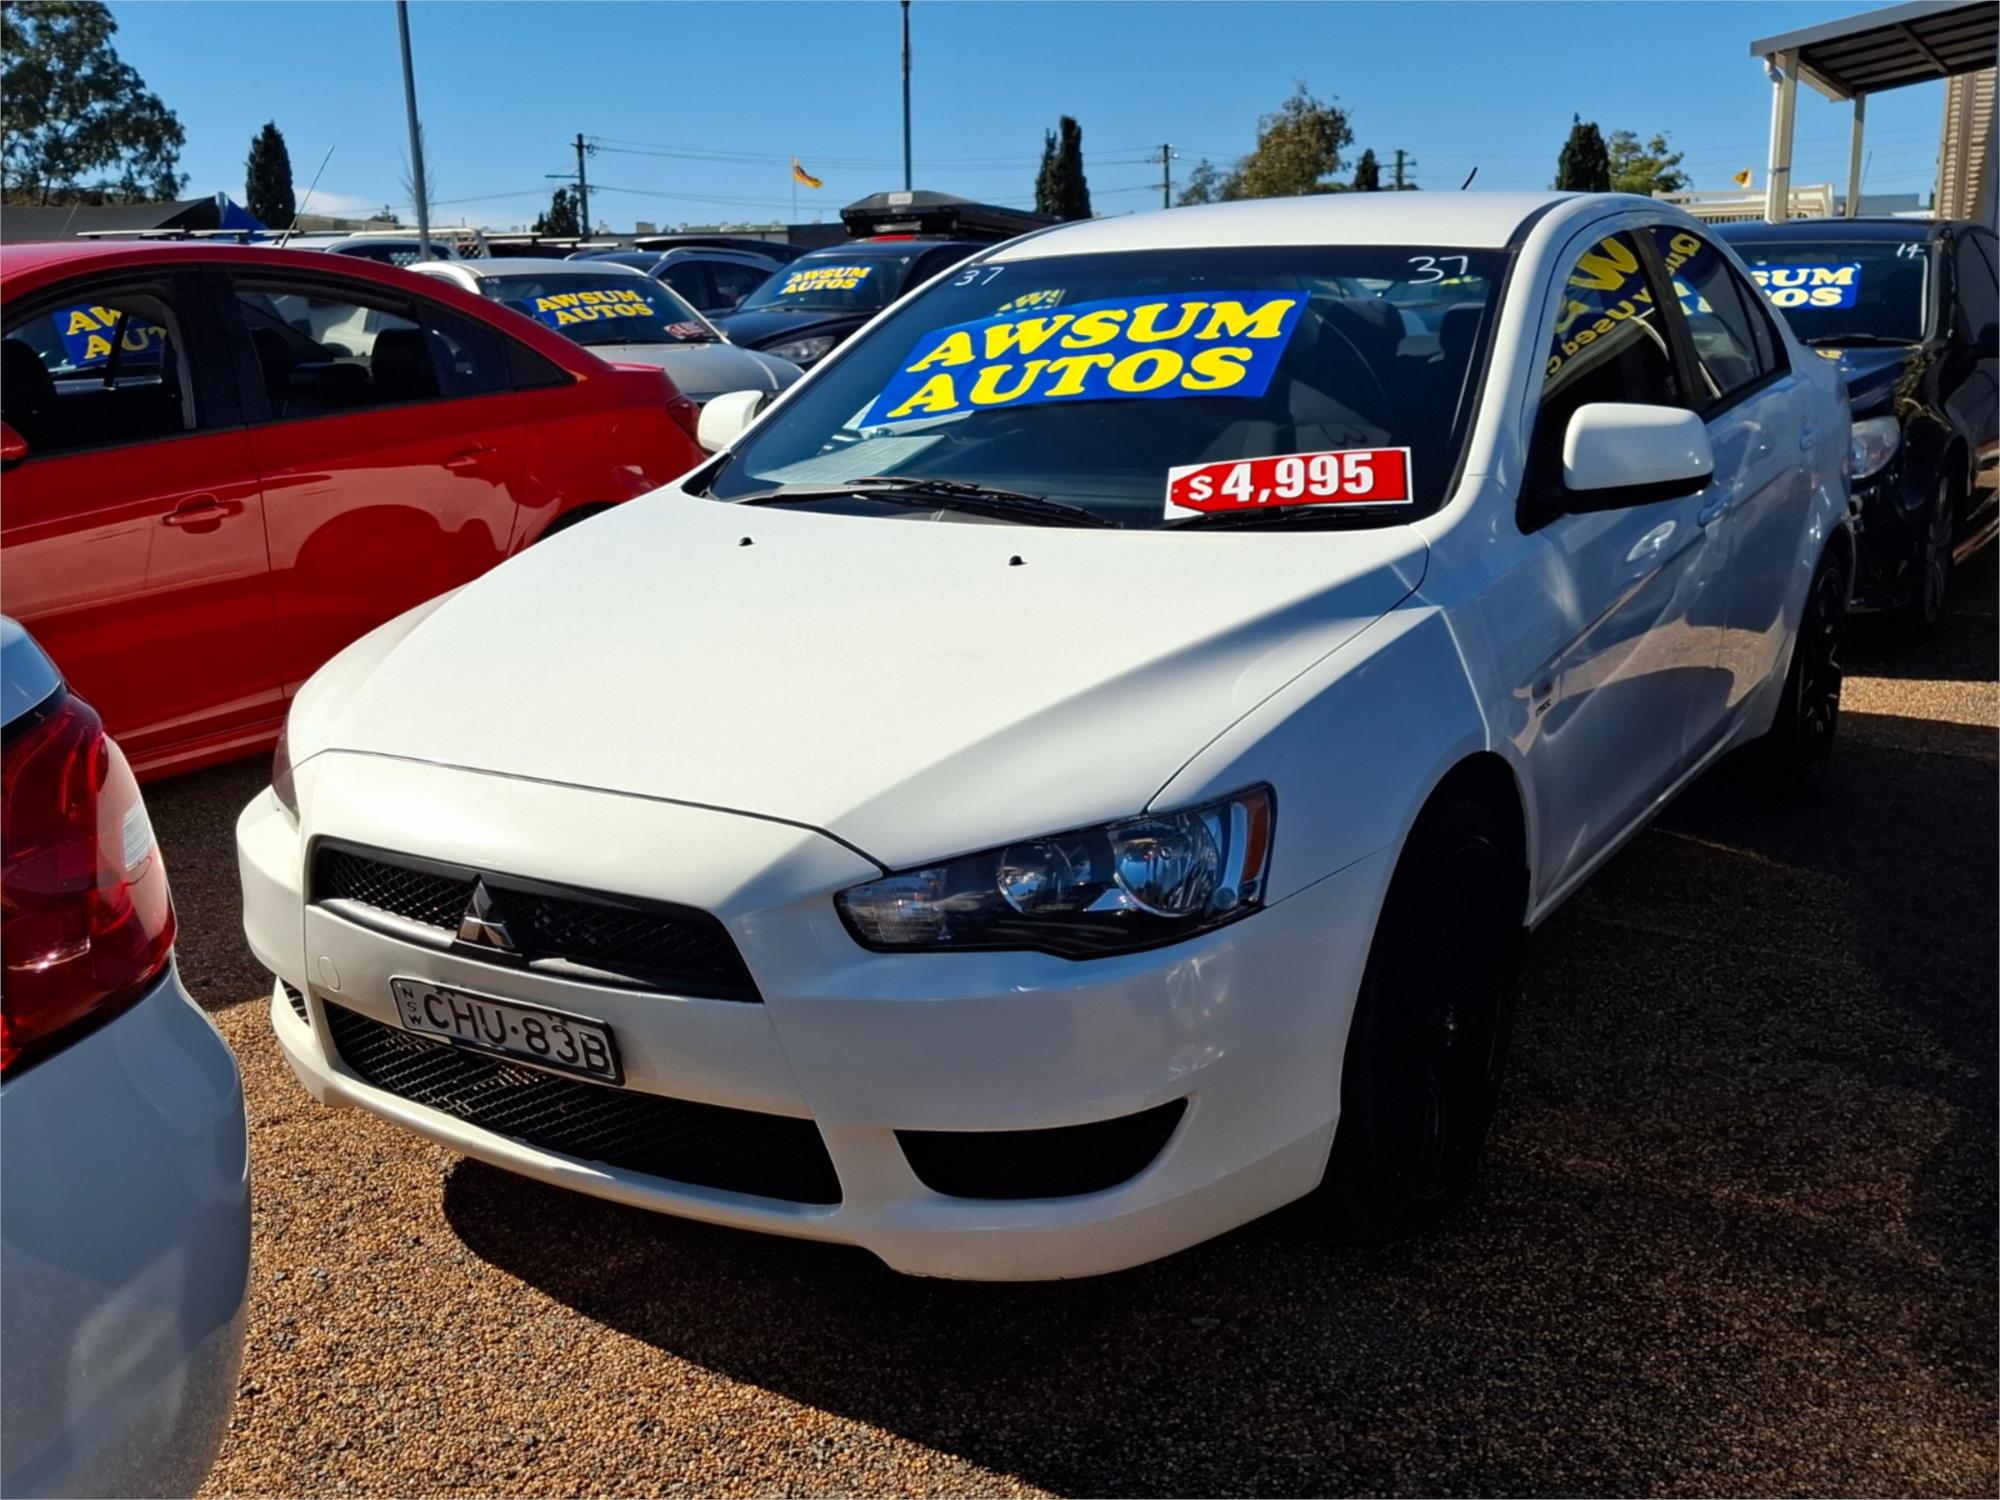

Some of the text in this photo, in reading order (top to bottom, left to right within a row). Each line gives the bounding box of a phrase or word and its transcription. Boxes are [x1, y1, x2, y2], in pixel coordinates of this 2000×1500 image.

[785, 266, 873, 286] AWSUM
[953, 265, 1005, 287] 37
[1407, 254, 1469, 284] 37
[779, 278, 859, 295] AUTOS
[535, 289, 645, 313] AWSUM
[555, 302, 655, 326] AUTOS
[906, 299, 1297, 373] AWSUM
[885, 345, 1254, 419] AUTOS
[401, 986, 423, 1026] NSW
